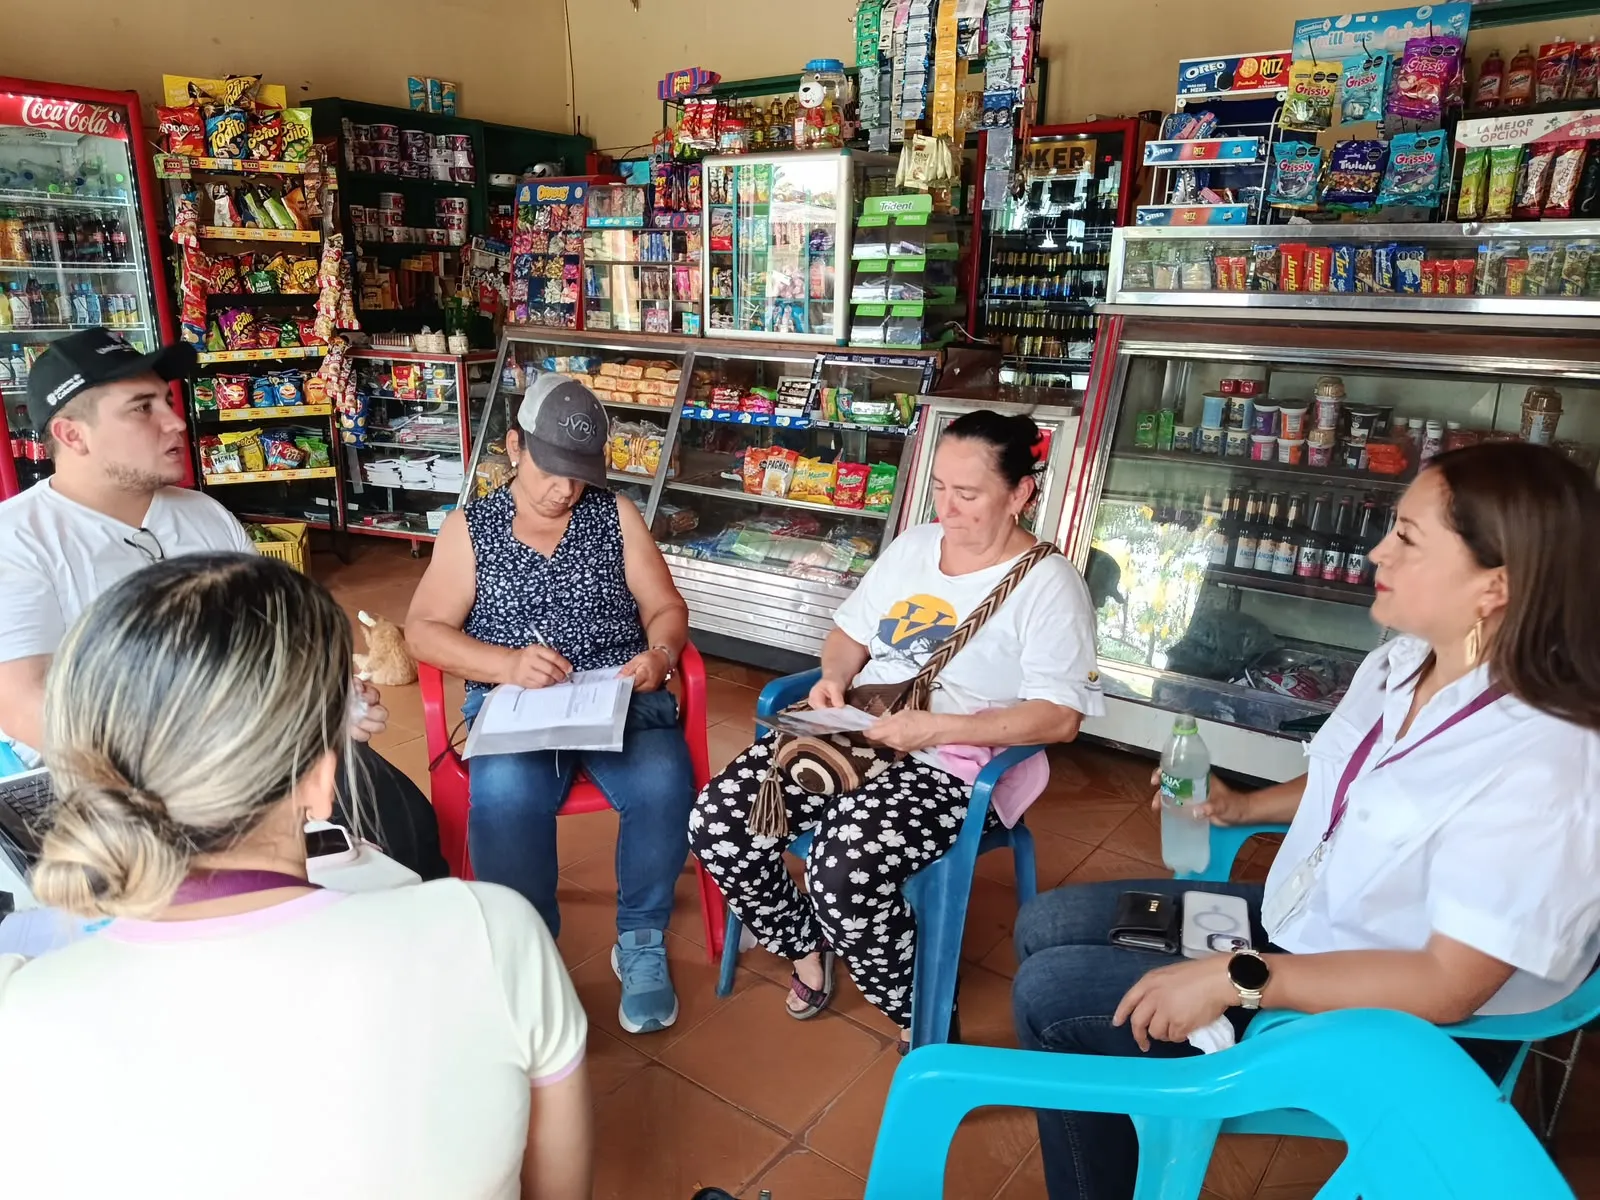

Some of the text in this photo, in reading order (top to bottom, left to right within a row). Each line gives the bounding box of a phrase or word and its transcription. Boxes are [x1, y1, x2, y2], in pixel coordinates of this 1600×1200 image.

[1185, 58, 1284, 79] OREO RITZ
[1408, 56, 1448, 73] Grissly
[1346, 73, 1377, 88] Grissly
[1181, 86, 1207, 94] MMENT
[1295, 82, 1330, 97] Grissly
[22, 98, 108, 135] Coca-Cola
[217, 116, 233, 133] De
[1494, 118, 1535, 132] MEJOR
[209, 120, 247, 157] Todito
[1026, 146, 1087, 170] KER
[1280, 158, 1315, 173] Grissly
[1338, 159, 1377, 171] Trululu
[1395, 151, 1436, 165] Grissly
[880, 201, 913, 211] Trident
[1287, 254, 1299, 291] Jumb
[1314, 251, 1325, 291] Jumb
[1335, 251, 1349, 278] Jet
